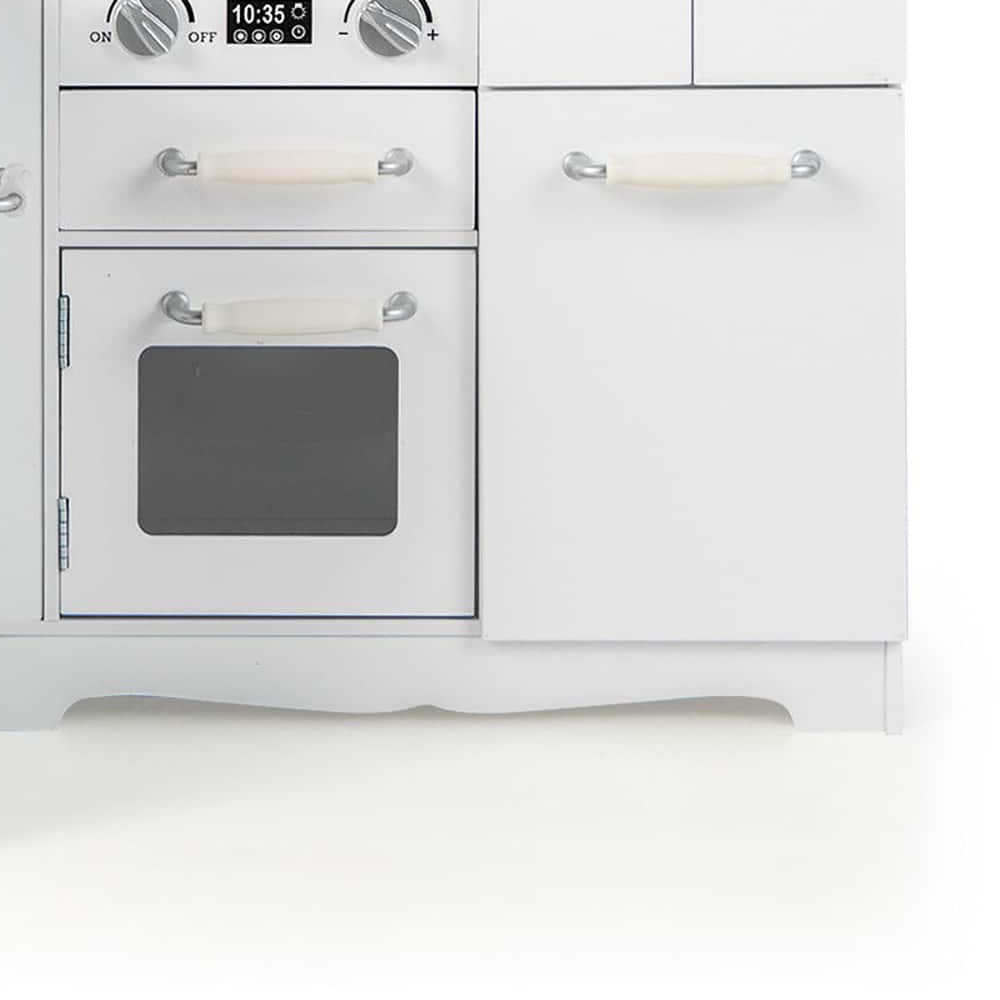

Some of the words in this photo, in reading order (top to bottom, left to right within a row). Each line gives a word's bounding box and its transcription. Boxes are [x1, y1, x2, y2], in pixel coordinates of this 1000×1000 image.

[232, 4, 285, 25] 10:35
[89, 31, 113, 44] ON
[188, 31, 218, 44] OFF
